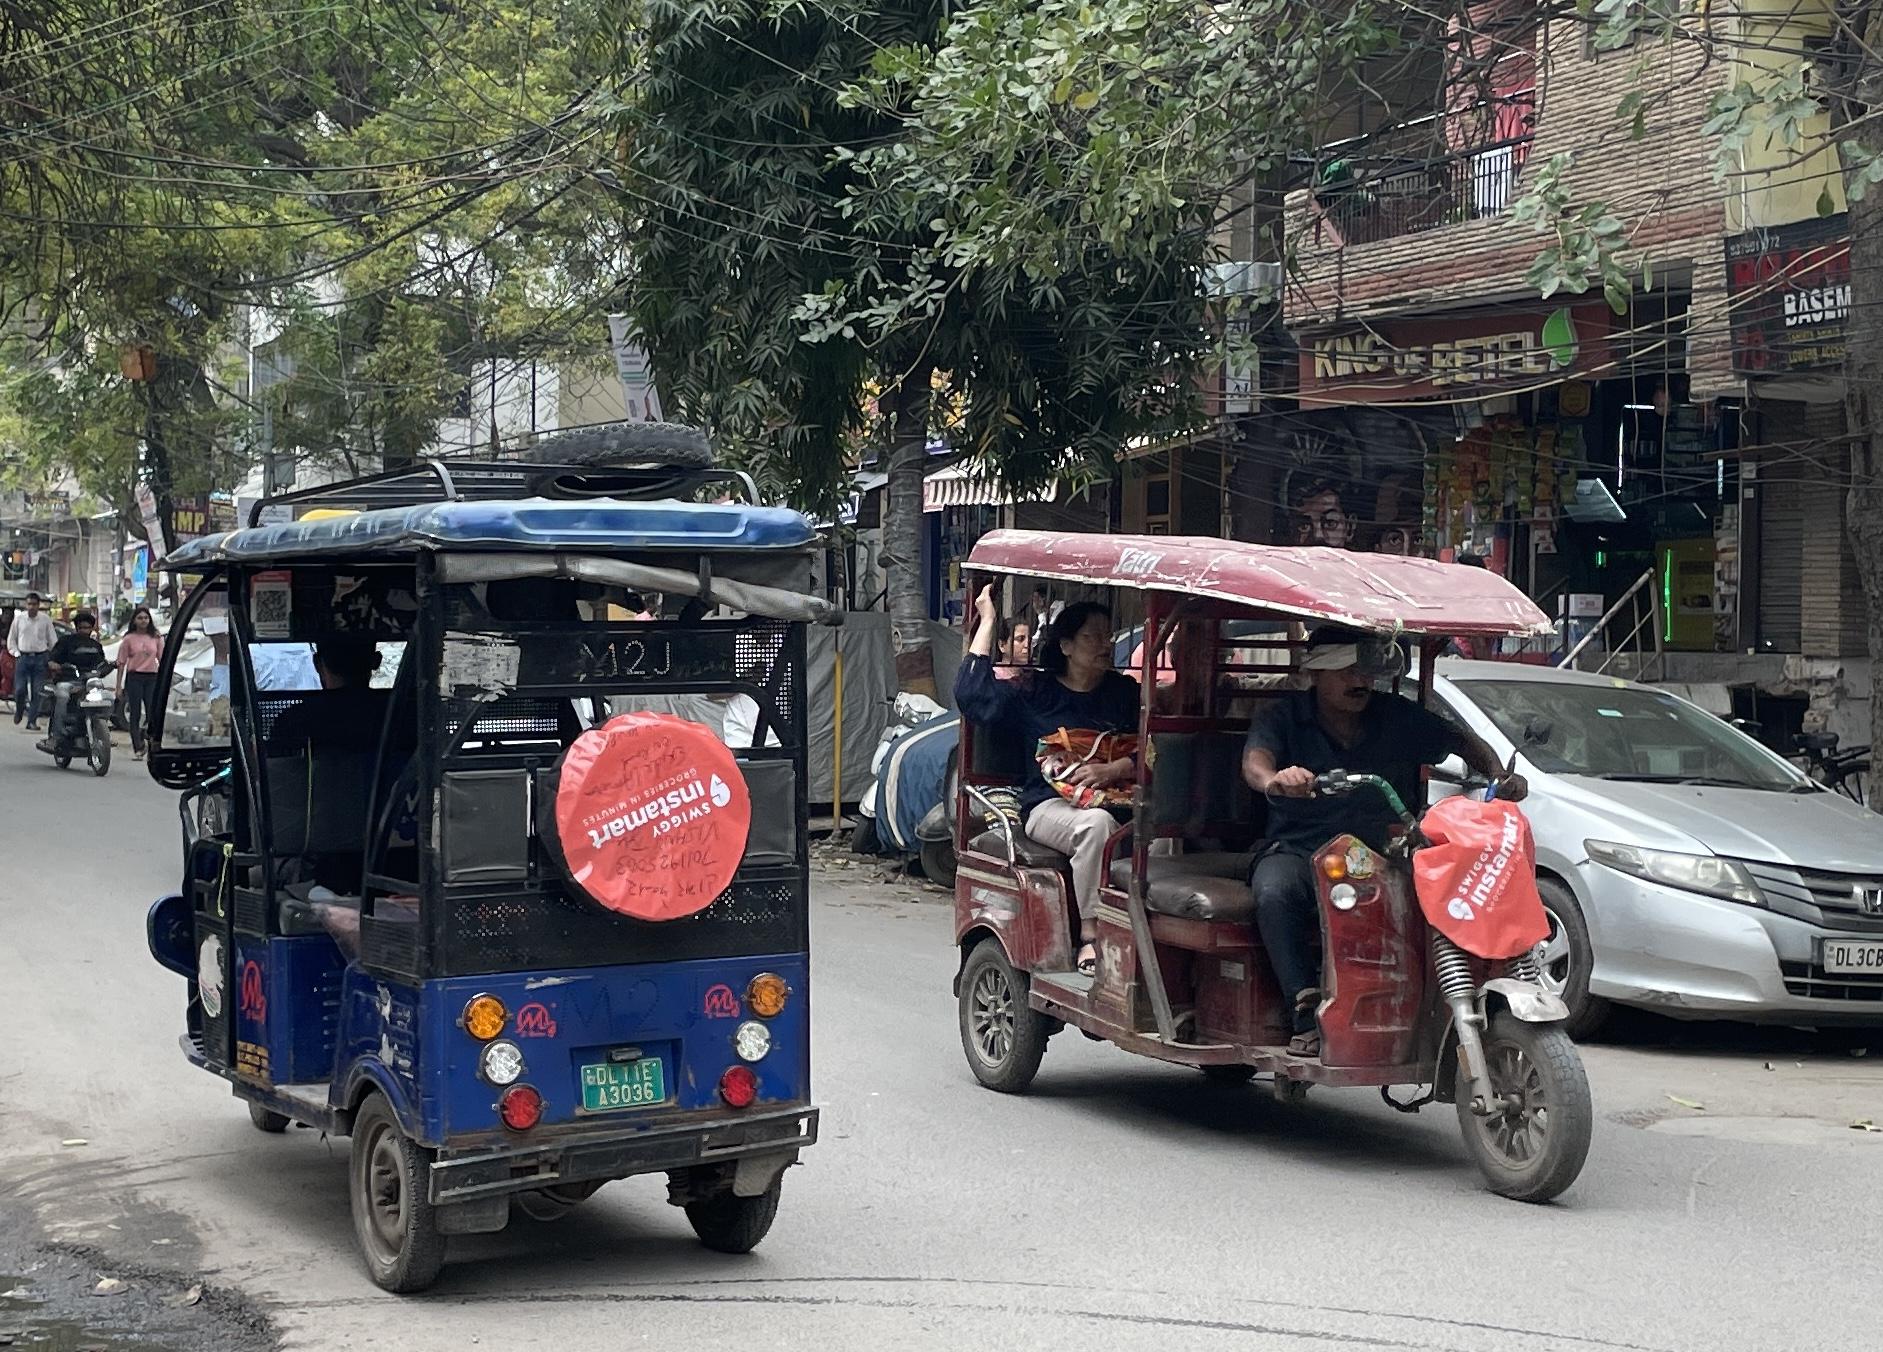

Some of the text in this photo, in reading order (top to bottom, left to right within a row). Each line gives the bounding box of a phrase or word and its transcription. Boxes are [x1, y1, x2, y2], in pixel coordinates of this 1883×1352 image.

[1314, 334, 1386, 379] KING
[629, 793, 641, 806] IN
[643, 768, 697, 798] GROCERIES
[582, 800, 628, 826] MINUTES
[588, 778, 706, 849] instamart
[652, 801, 712, 838] SWIGGY
[1458, 843, 1494, 895] SWIGGY
[1470, 812, 1518, 907] instamart
[599, 1082, 655, 1106] A3036
